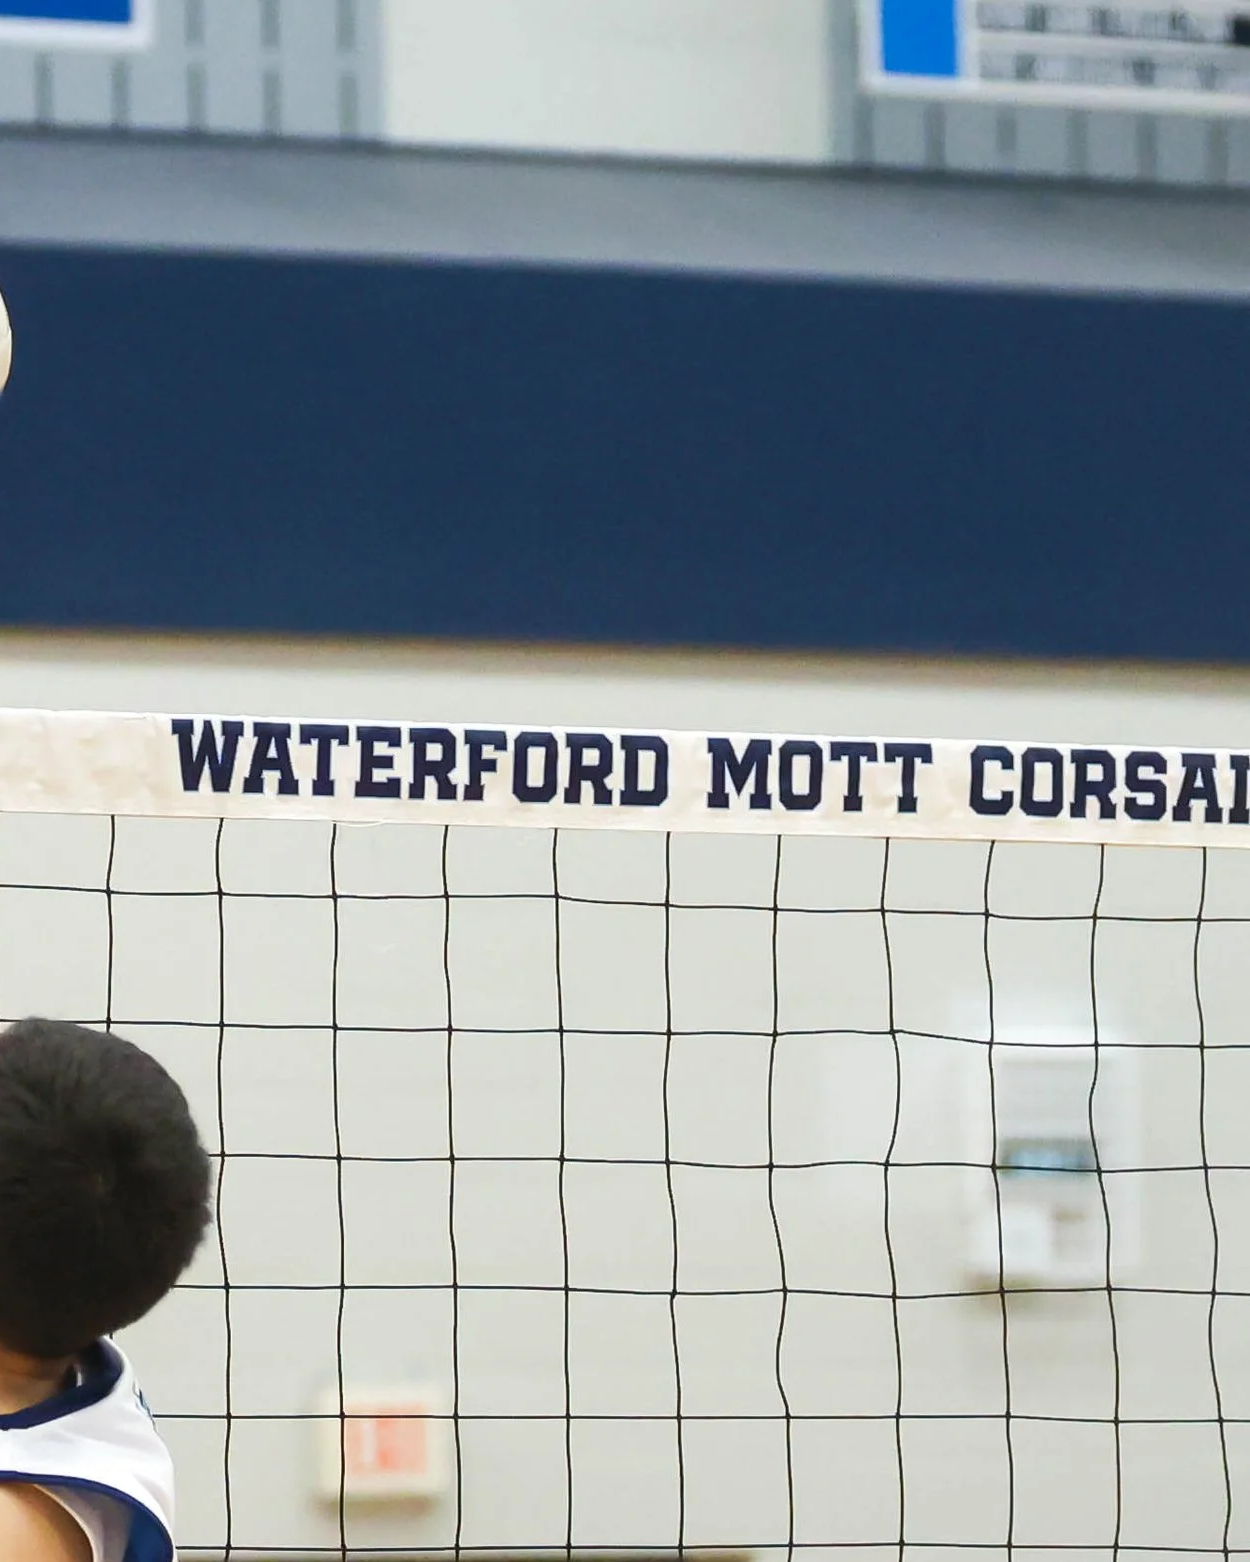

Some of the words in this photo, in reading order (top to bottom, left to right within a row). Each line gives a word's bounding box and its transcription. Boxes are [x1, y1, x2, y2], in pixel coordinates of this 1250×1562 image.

[172, 719, 668, 806] WATERFORD
[708, 738, 932, 812] MOTT
[970, 746, 1250, 824] CORSAI
